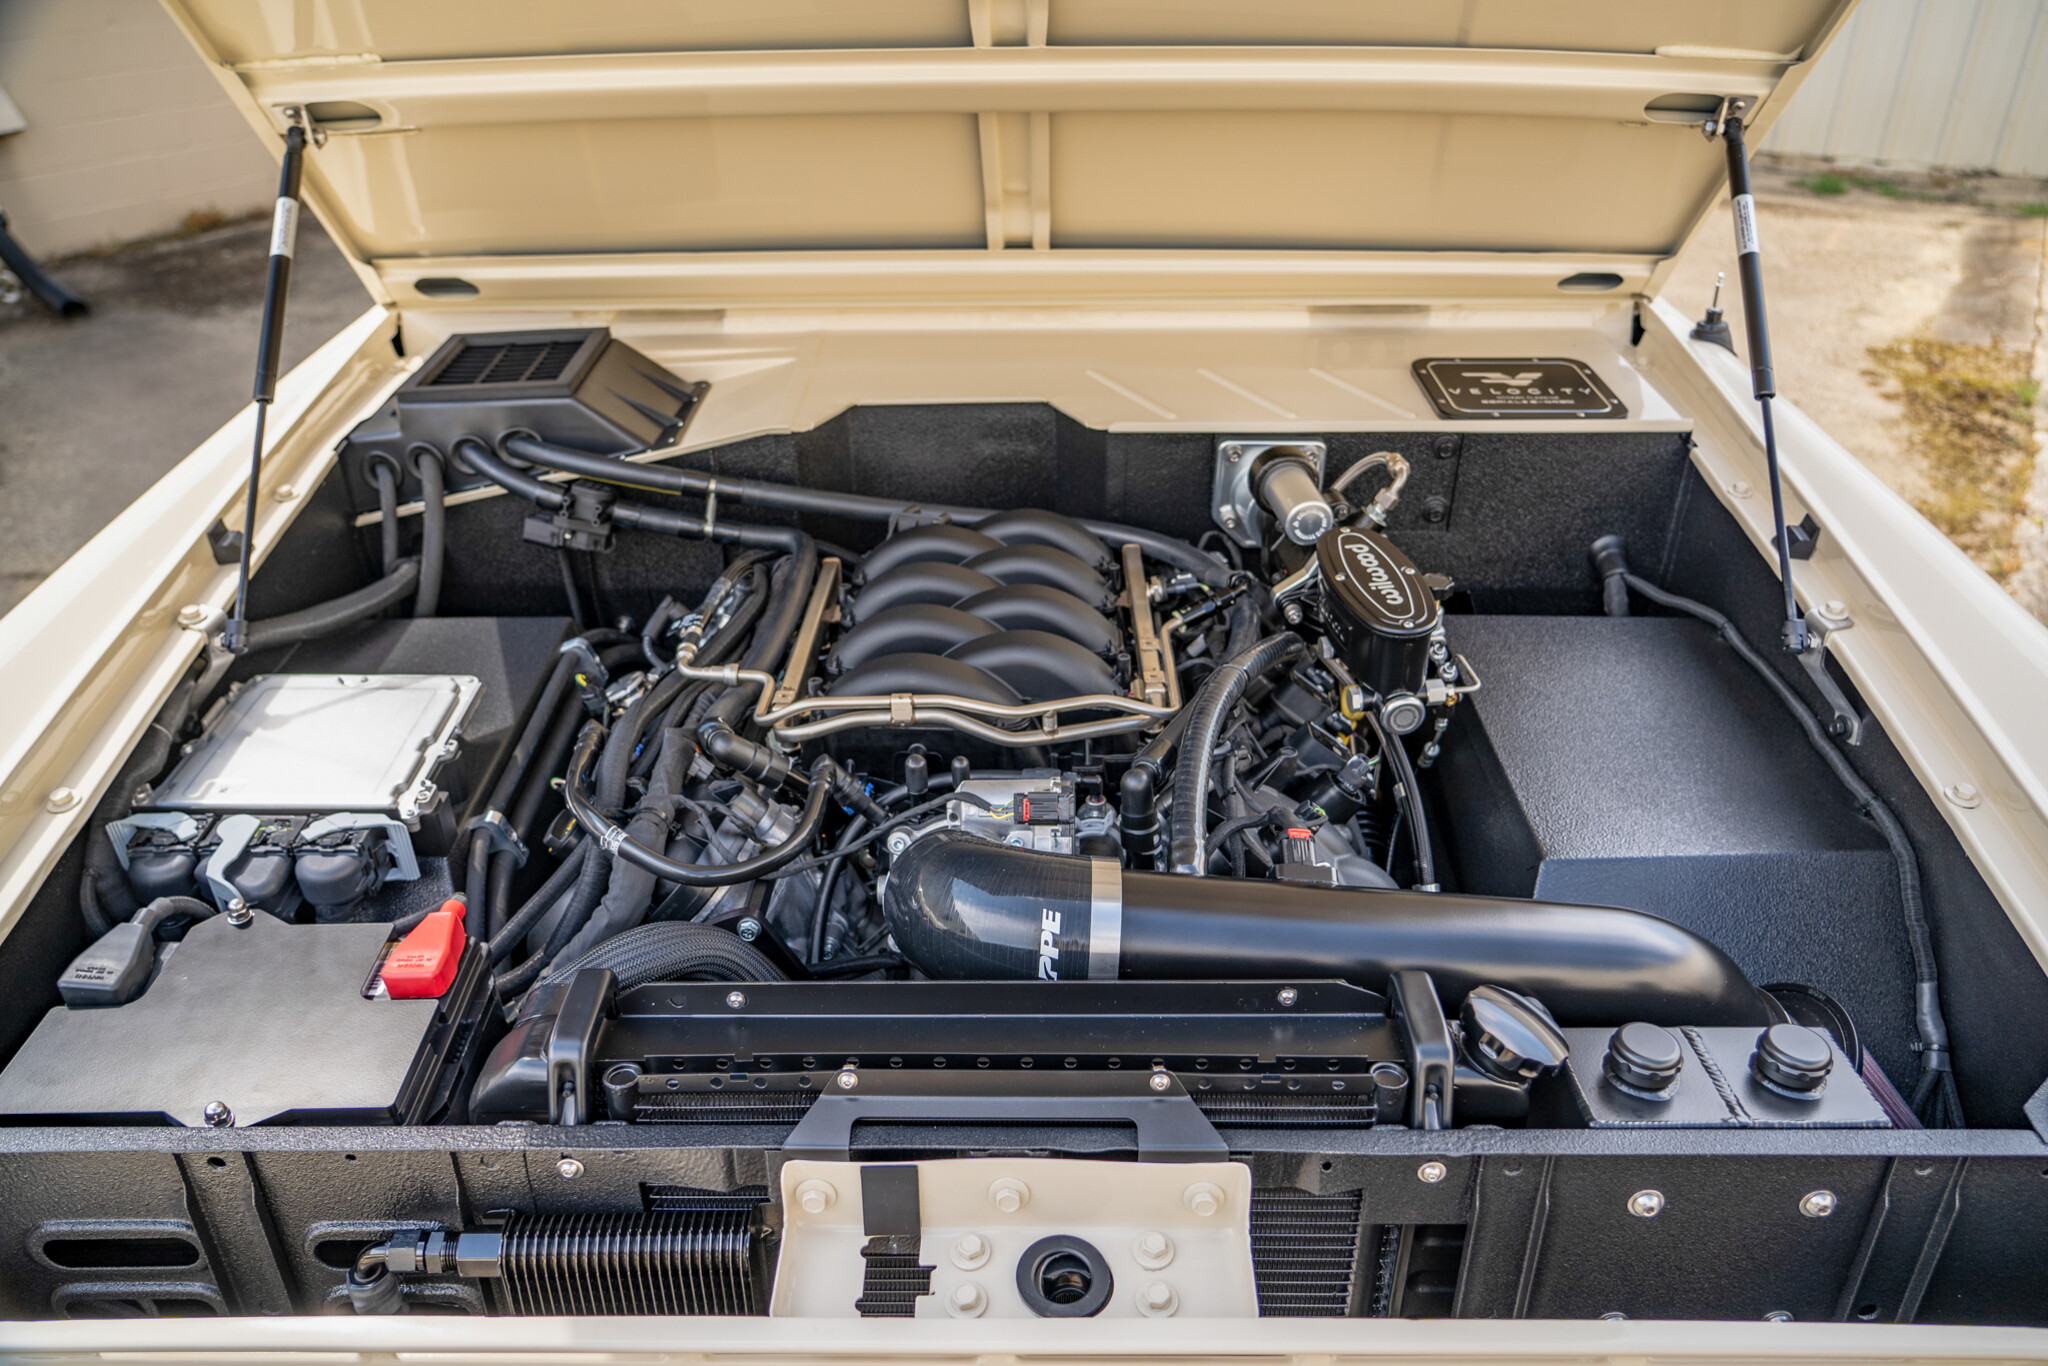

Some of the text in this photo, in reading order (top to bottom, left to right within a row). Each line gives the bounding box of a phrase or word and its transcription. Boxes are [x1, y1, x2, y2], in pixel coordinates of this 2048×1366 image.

[1448, 387, 1591, 395] VELOCITY
[1344, 544, 1404, 605] wilwood
[1038, 908, 1061, 981] PPE
